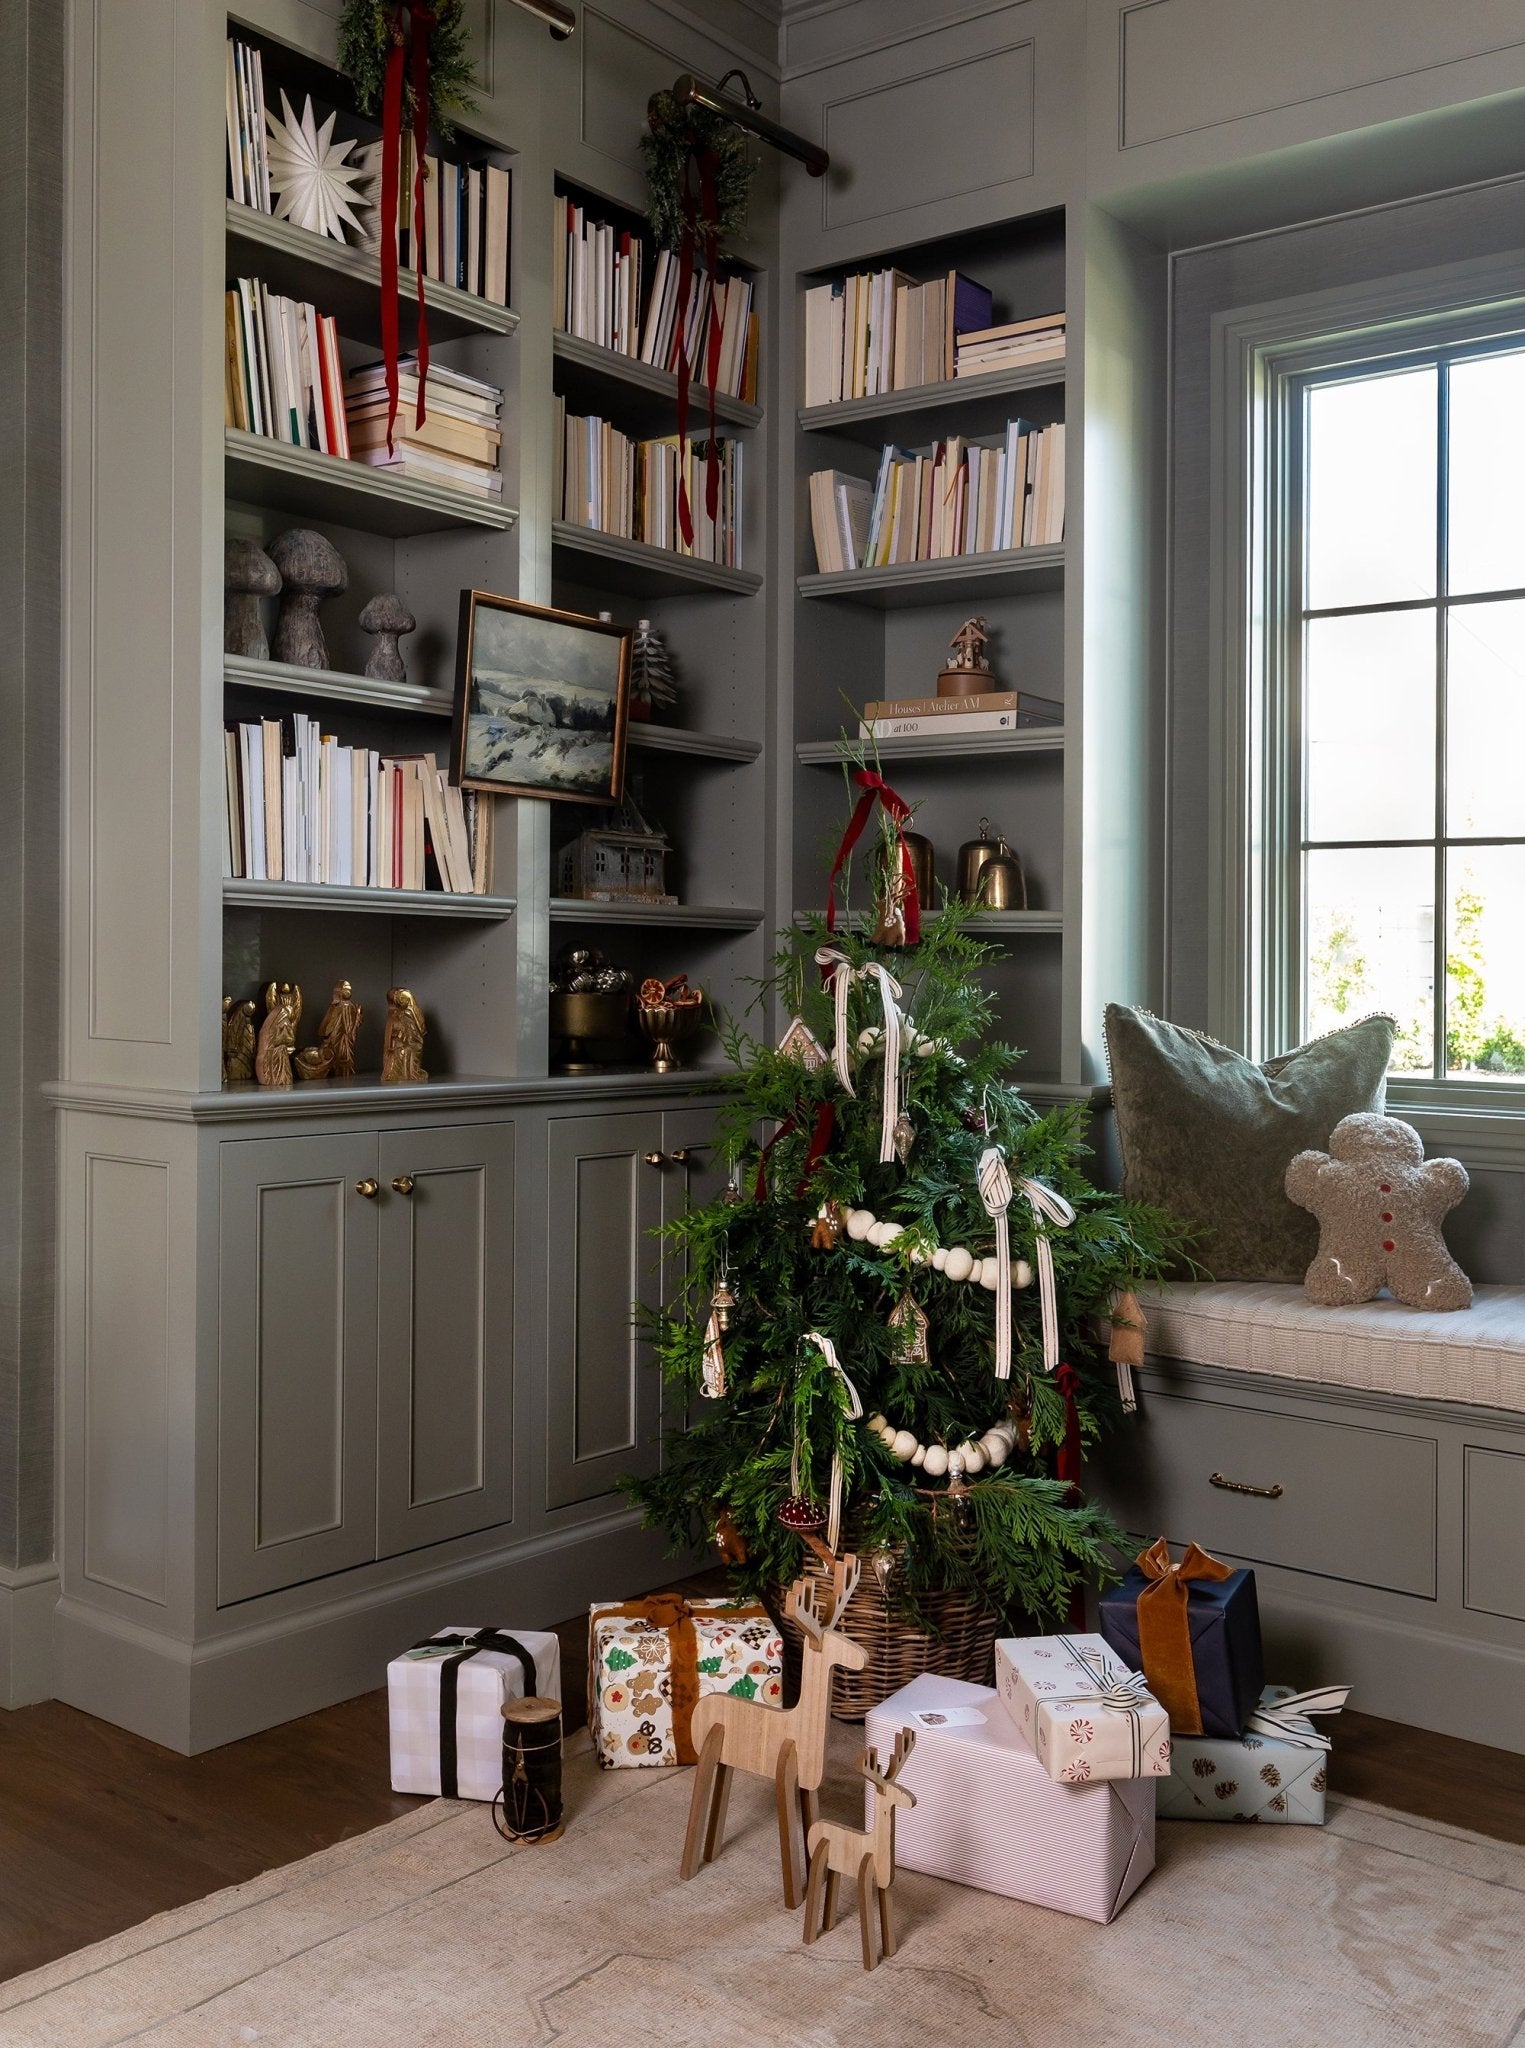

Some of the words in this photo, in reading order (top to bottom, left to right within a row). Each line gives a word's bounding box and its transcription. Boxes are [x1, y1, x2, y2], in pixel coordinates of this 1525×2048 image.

[889, 703, 921, 715] Houses
[928, 698, 959, 712] Atelier
[962, 696, 980, 710] AM
[893, 724, 902, 733] at
[903, 722, 919, 733] 100
